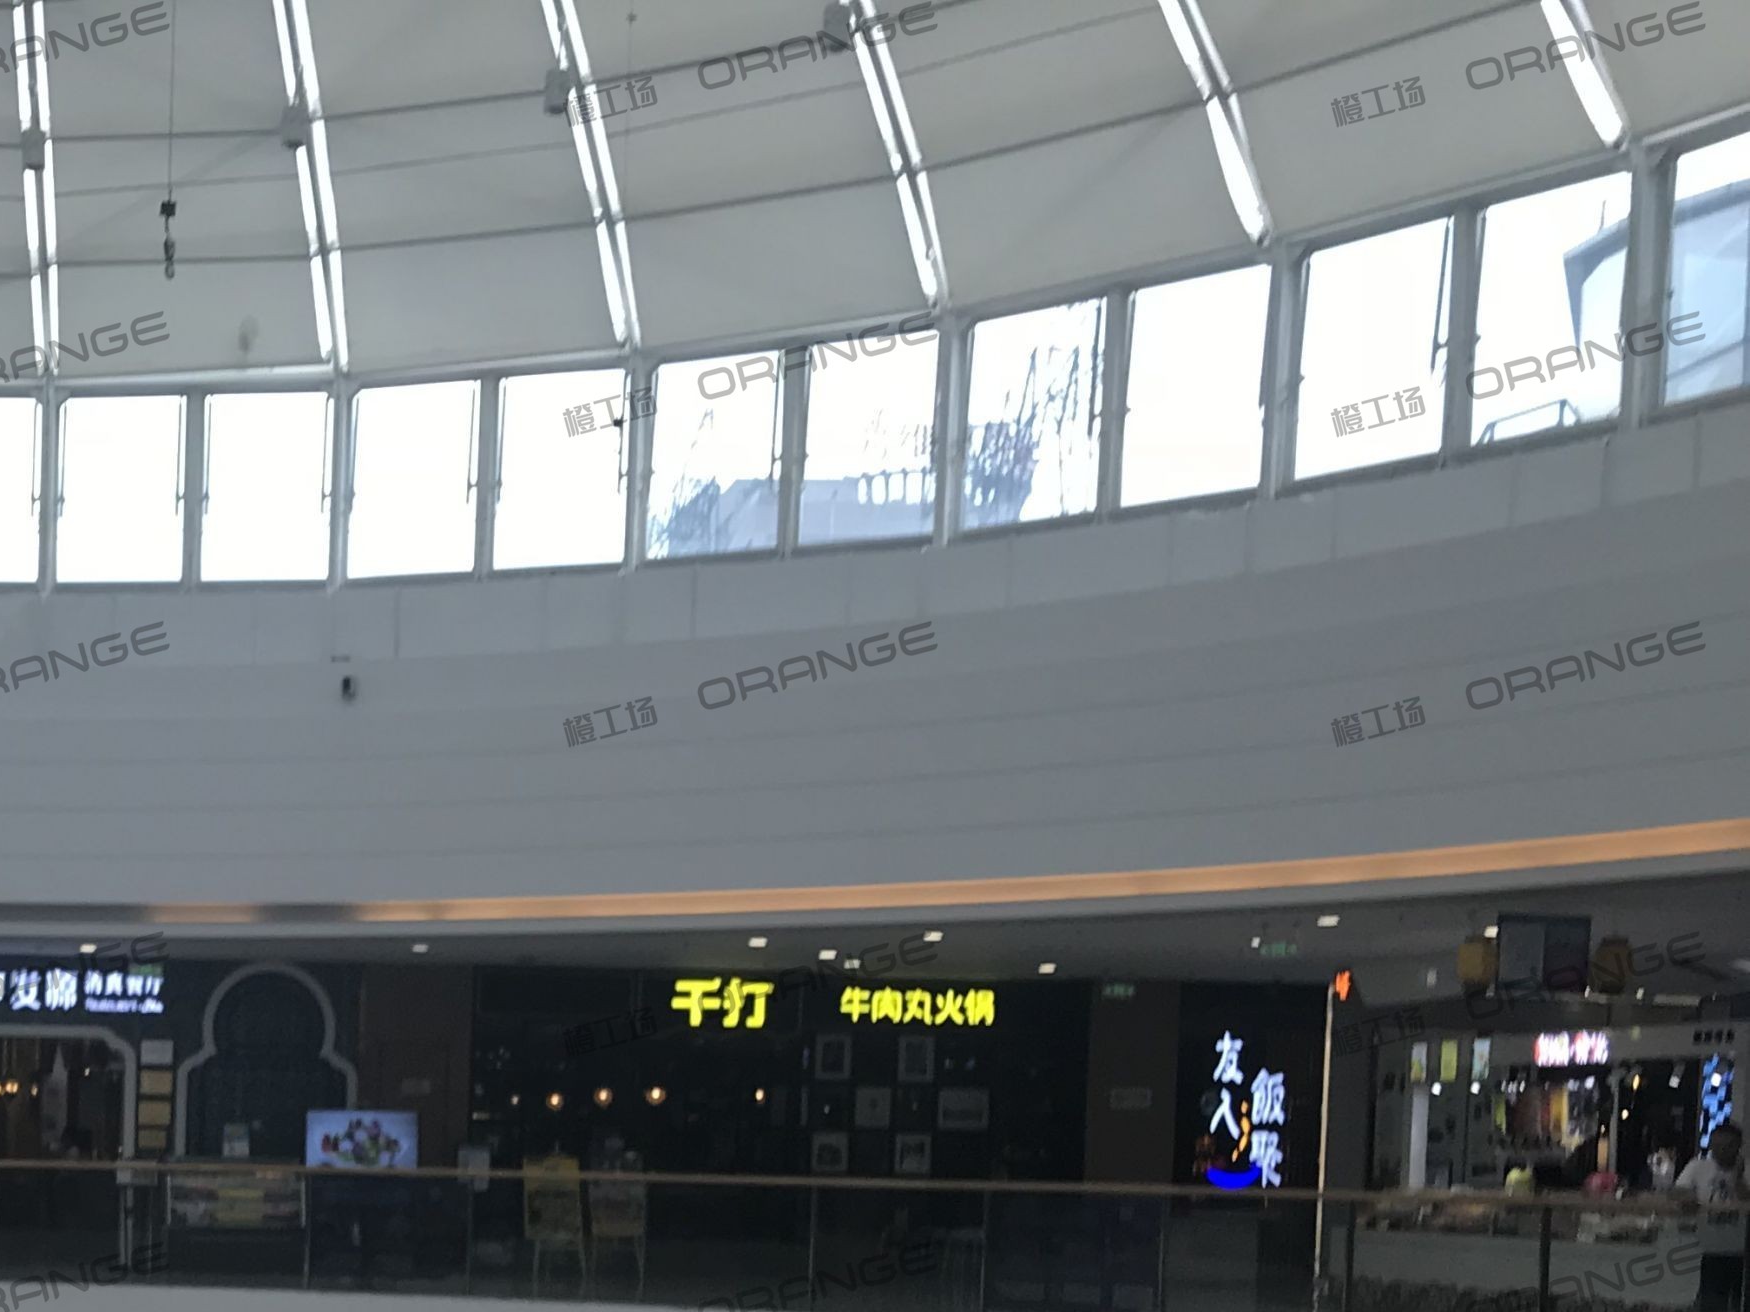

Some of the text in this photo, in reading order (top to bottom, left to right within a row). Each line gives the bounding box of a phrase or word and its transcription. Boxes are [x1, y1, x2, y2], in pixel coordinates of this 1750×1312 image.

[840, 985, 995, 1027] 牛肉丸火锅
